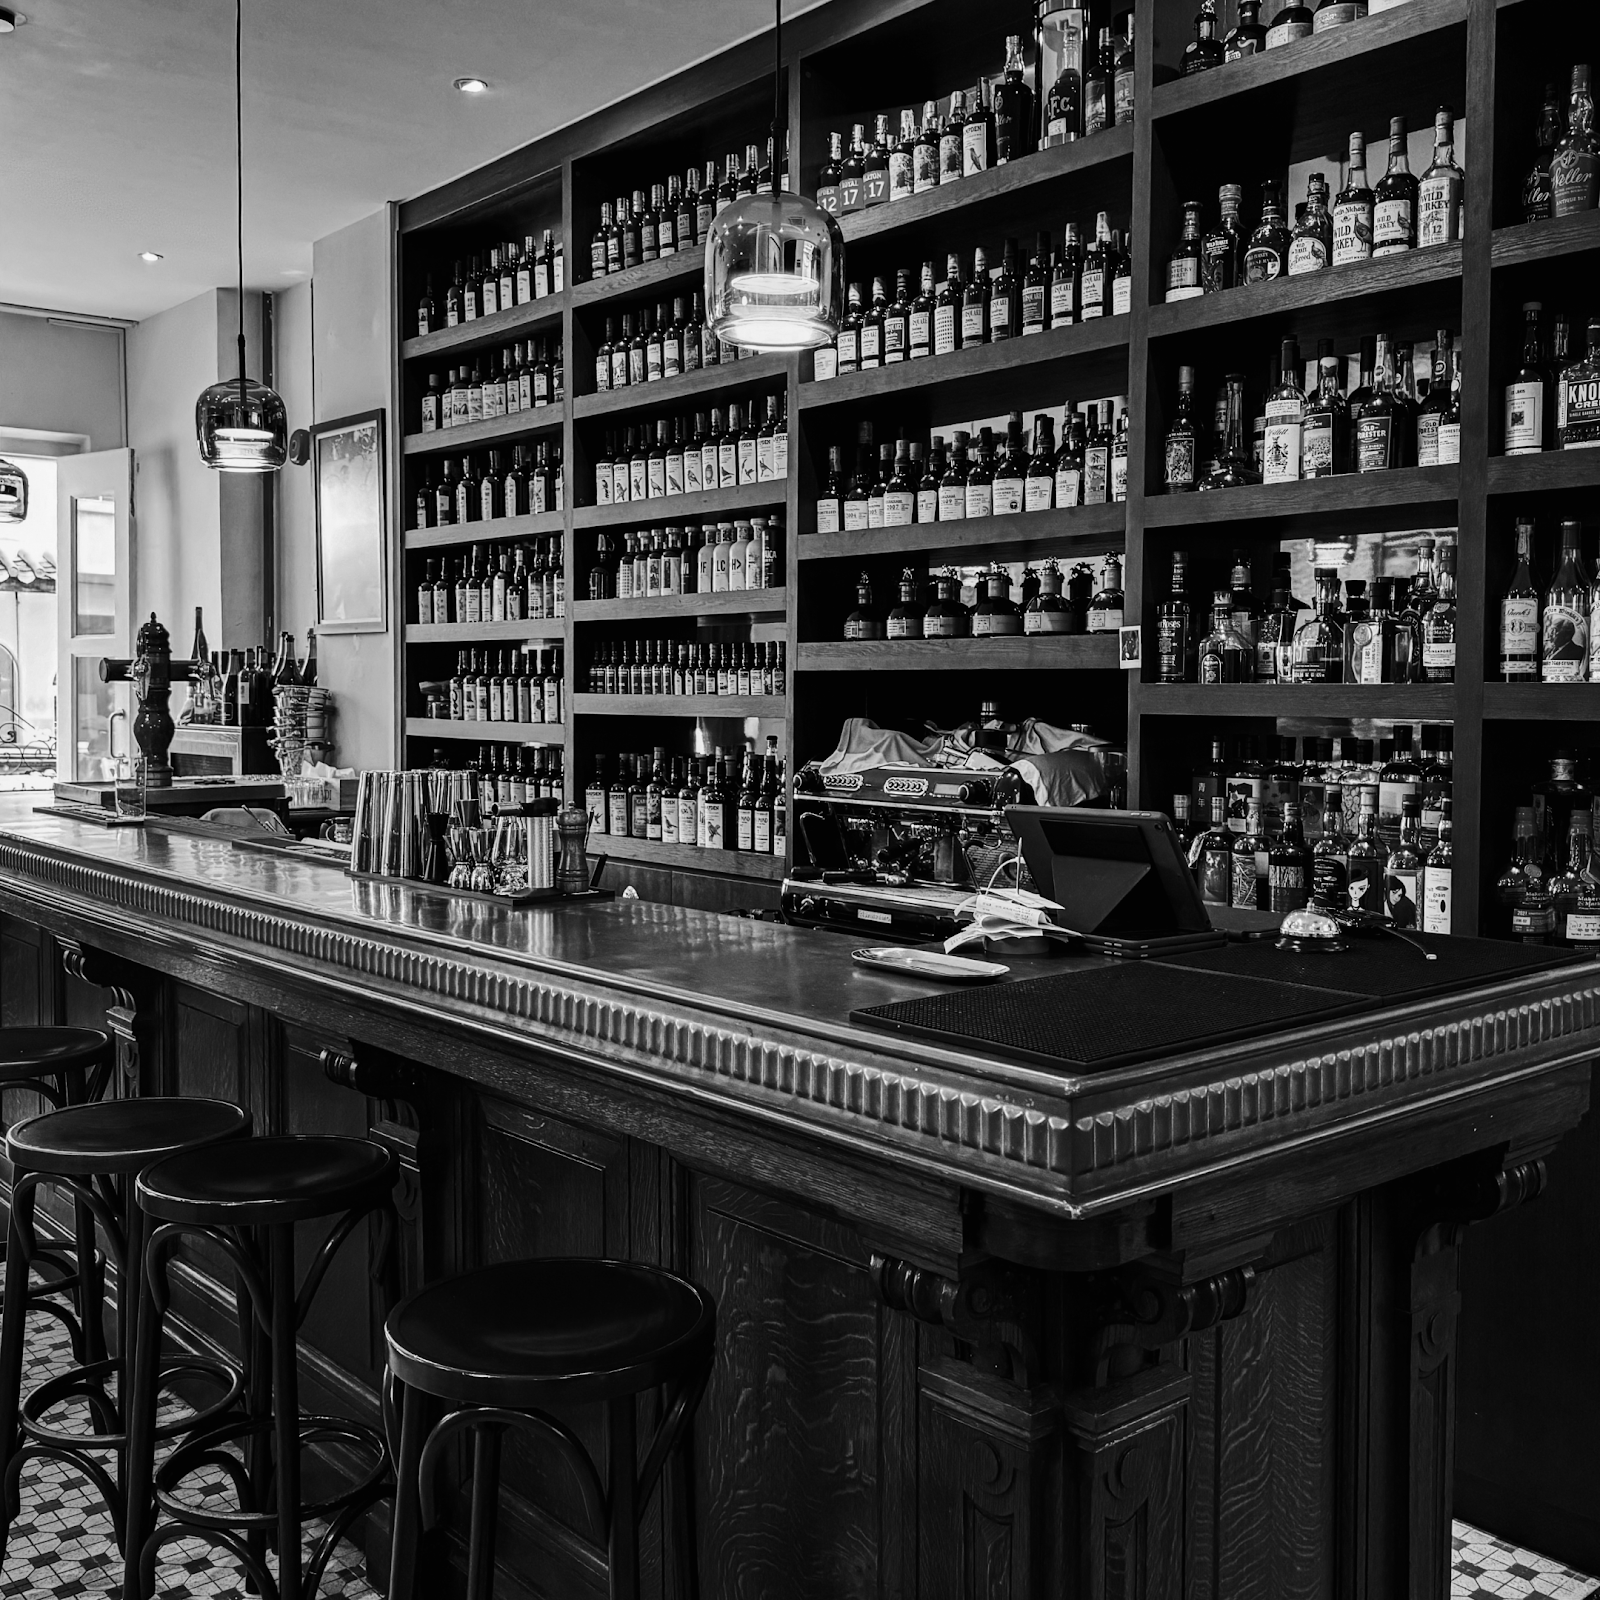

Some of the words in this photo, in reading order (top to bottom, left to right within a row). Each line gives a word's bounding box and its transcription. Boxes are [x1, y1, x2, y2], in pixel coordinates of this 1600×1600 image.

[868, 181, 885, 197] 17
[821, 197, 837, 212] 12
[843, 189, 858, 205] 17
[1433, 225, 1443, 234] 12
[1568, 381, 1600, 403] KNO
[1575, 399, 1600, 409] CRE
